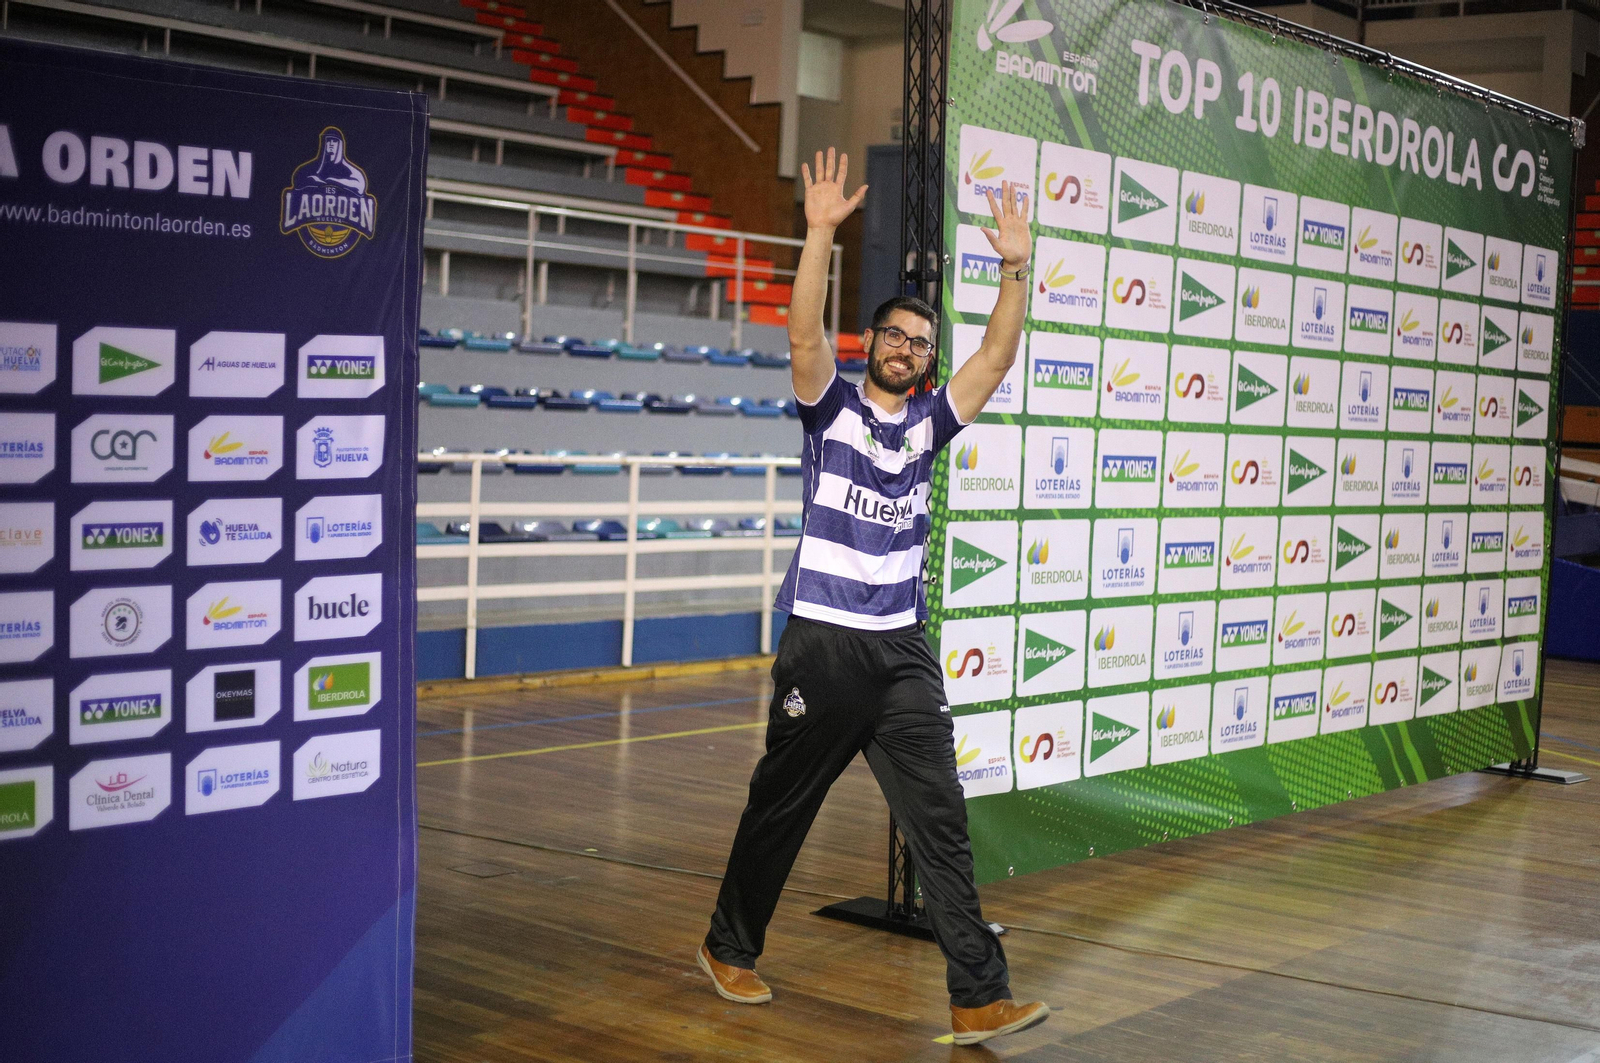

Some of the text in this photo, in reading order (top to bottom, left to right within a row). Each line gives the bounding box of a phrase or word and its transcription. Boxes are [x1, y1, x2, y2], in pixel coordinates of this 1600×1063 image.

[1063, 51, 1098, 68] ESPAÑA
[996, 50, 1096, 95] BADMINTON
[1132, 39, 1482, 191] TOP 10 IBERDROLA
[42, 130, 252, 198] ORDEN
[1188, 219, 1233, 239] IBERDROLA
[1318, 225, 1342, 246] YONEX
[1250, 230, 1286, 248] LOTERÍAS
[309, 240, 348, 254] BADMINTON
[1359, 252, 1392, 267] BADMINTON
[1048, 292, 1097, 308] BADMINTON
[1244, 314, 1286, 330] IBERDROLA
[1364, 312, 1386, 331] YONEX
[1402, 335, 1433, 346] BADMINTON
[4, 356, 40, 365] HUELVA
[335, 360, 372, 375] YONEX
[1056, 365, 1090, 387] YONEX
[1115, 391, 1160, 403] BADMINTON
[1406, 392, 1427, 409] YONEX
[1295, 400, 1334, 414] IBERDROLA
[0, 440, 43, 451] TERÍAS
[214, 456, 268, 465] BADMINTON
[336, 453, 369, 462] HUELVA
[1122, 459, 1153, 478] YONEX
[960, 477, 1014, 490] IBERDROLA
[1035, 477, 1080, 490] LOTERÍAS
[1176, 481, 1218, 492] BADMINTON
[1342, 480, 1378, 491] IBERDROLA
[225, 523, 259, 532] HUELVA
[327, 521, 372, 532] LOTERÍAS
[115, 527, 158, 544] YONEX
[237, 532, 272, 540] SALUDA
[1182, 546, 1211, 565] YONEX
[1386, 552, 1420, 564] IBERDROLA
[1102, 565, 1144, 580] LOTERÍAS
[1232, 561, 1271, 573] BADMINTON
[1031, 569, 1082, 584] IBERDROLA
[308, 593, 369, 620] bucle
[213, 620, 267, 631] BADMINTON
[1238, 624, 1265, 643] YONEX
[1284, 636, 1320, 649] BADMINTON
[1098, 652, 1146, 670] IBERDROLA
[1164, 646, 1203, 662] LOTERÍAS
[216, 689, 252, 698] OKEYMAS
[318, 690, 365, 702] IBERDROLA
[113, 699, 156, 718] YONEX
[1289, 695, 1314, 715] YONEX
[1331, 705, 1364, 719] BADMINTON
[0, 708, 26, 718] ELVA
[2, 716, 42, 727] SALUDA
[1220, 719, 1256, 737] LOTERÍAS
[1160, 729, 1204, 747] IBERDROLA
[330, 760, 367, 773] Natura
[958, 764, 1007, 781] ADMINTON
[220, 769, 269, 784] LOTERÍAS
[308, 776, 332, 784] CENTRO
[86, 788, 154, 806] Clínica Dental
[0, 812, 29, 823] ROLA
